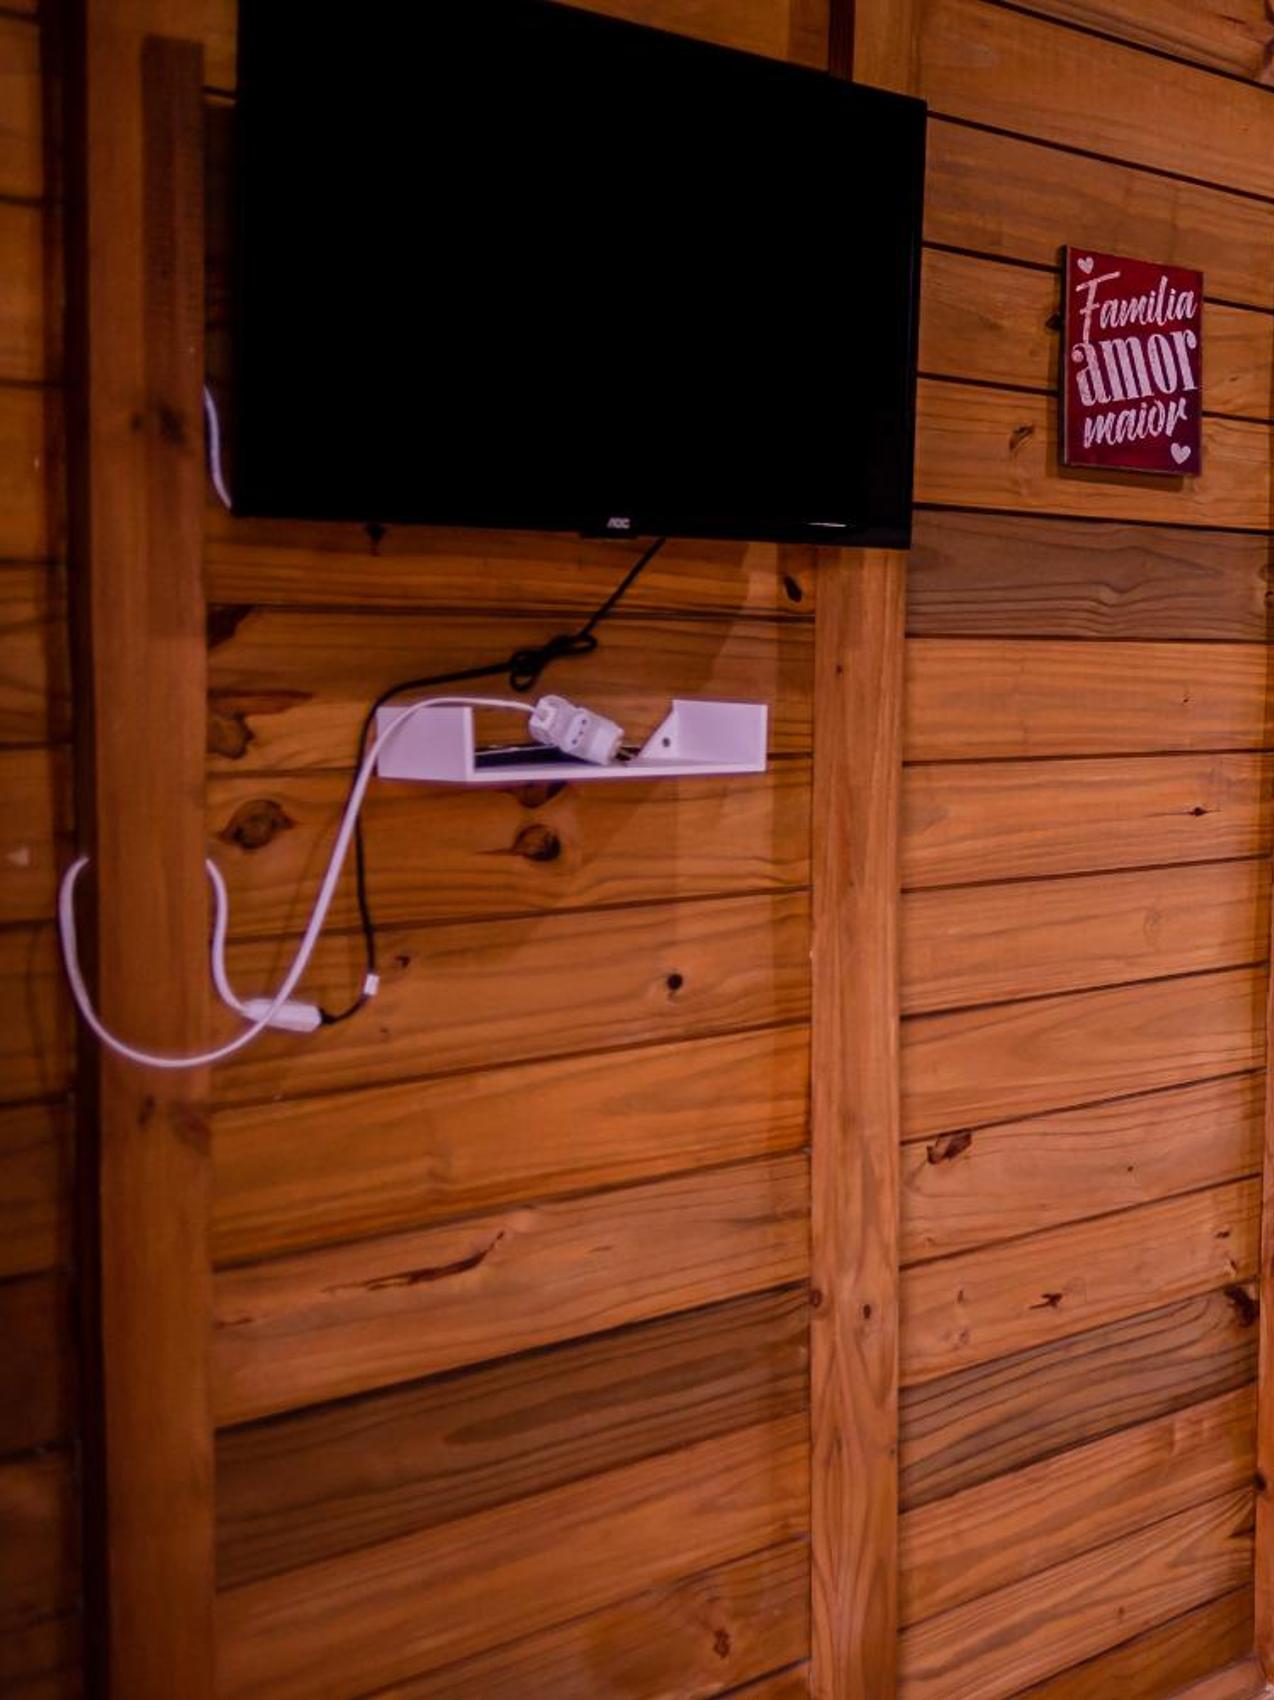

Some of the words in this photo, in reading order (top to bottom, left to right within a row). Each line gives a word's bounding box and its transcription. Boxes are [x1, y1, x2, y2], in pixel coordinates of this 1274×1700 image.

[1072, 329, 1198, 407] amor
[1084, 397, 1188, 449] maior
[606, 516, 631, 529] AOC
